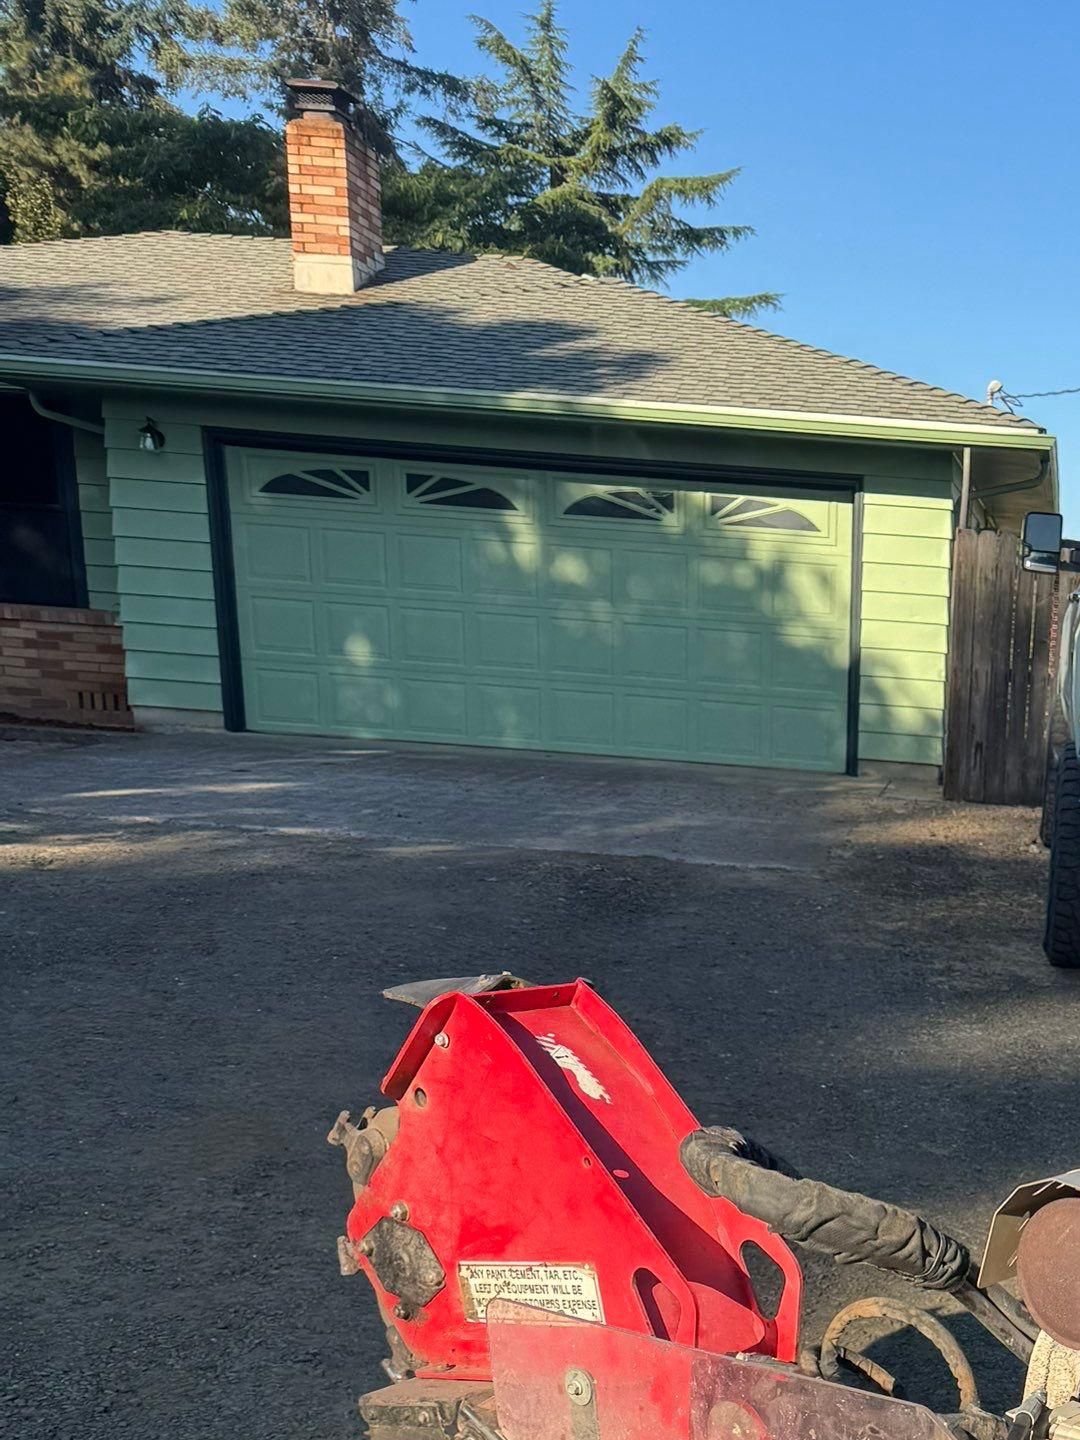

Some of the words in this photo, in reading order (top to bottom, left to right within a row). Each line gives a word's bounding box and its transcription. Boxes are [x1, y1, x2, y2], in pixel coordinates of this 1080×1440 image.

[493, 1284, 505, 1295] ON
[507, 1283, 550, 1295] EQUIPMENT
[551, 1285, 571, 1295] WILL
[572, 1285, 583, 1295] BE
[562, 1300, 598, 1310] EXPENSE
